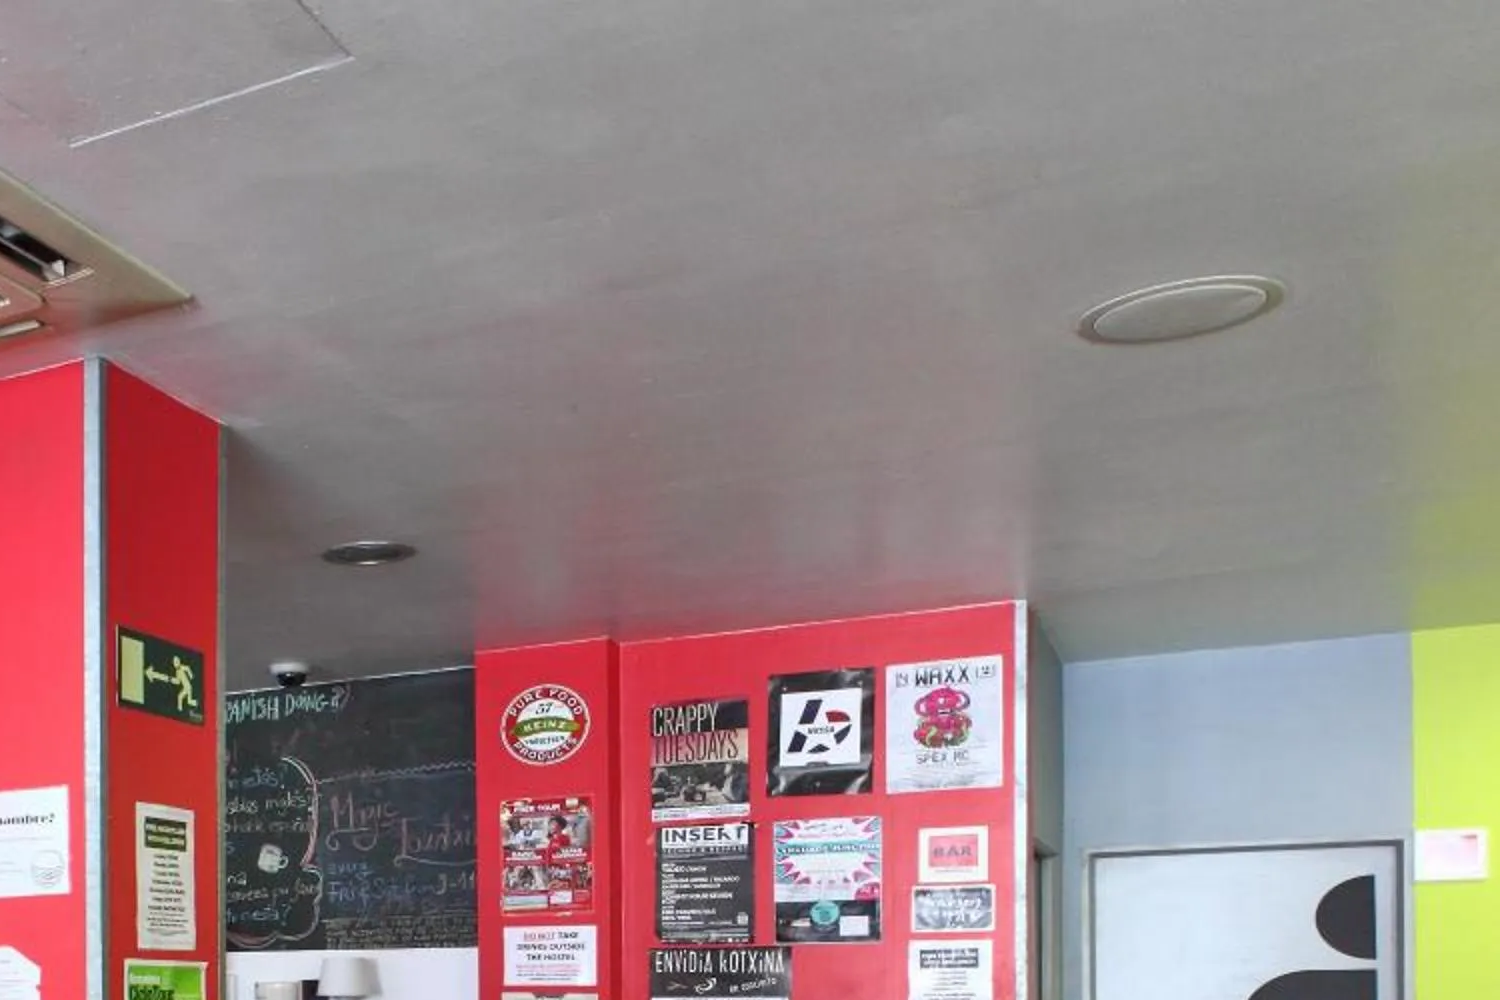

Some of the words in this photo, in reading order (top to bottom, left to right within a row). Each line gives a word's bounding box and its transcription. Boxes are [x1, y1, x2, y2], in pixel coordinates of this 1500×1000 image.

[914, 665, 970, 686] WAXX
[226, 692, 279, 723] PANISH
[509, 690, 542, 717] PURE
[549, 688, 582, 715] FOOD
[535, 702, 553, 714] 57
[652, 703, 719, 737] CRAPPY
[514, 738, 578, 761] PRODUCTS
[653, 731, 740, 764] TUESDAYS
[915, 753, 947, 764] SPEX
[664, 825, 747, 843] INSERT
[933, 846, 972, 857] BAR
